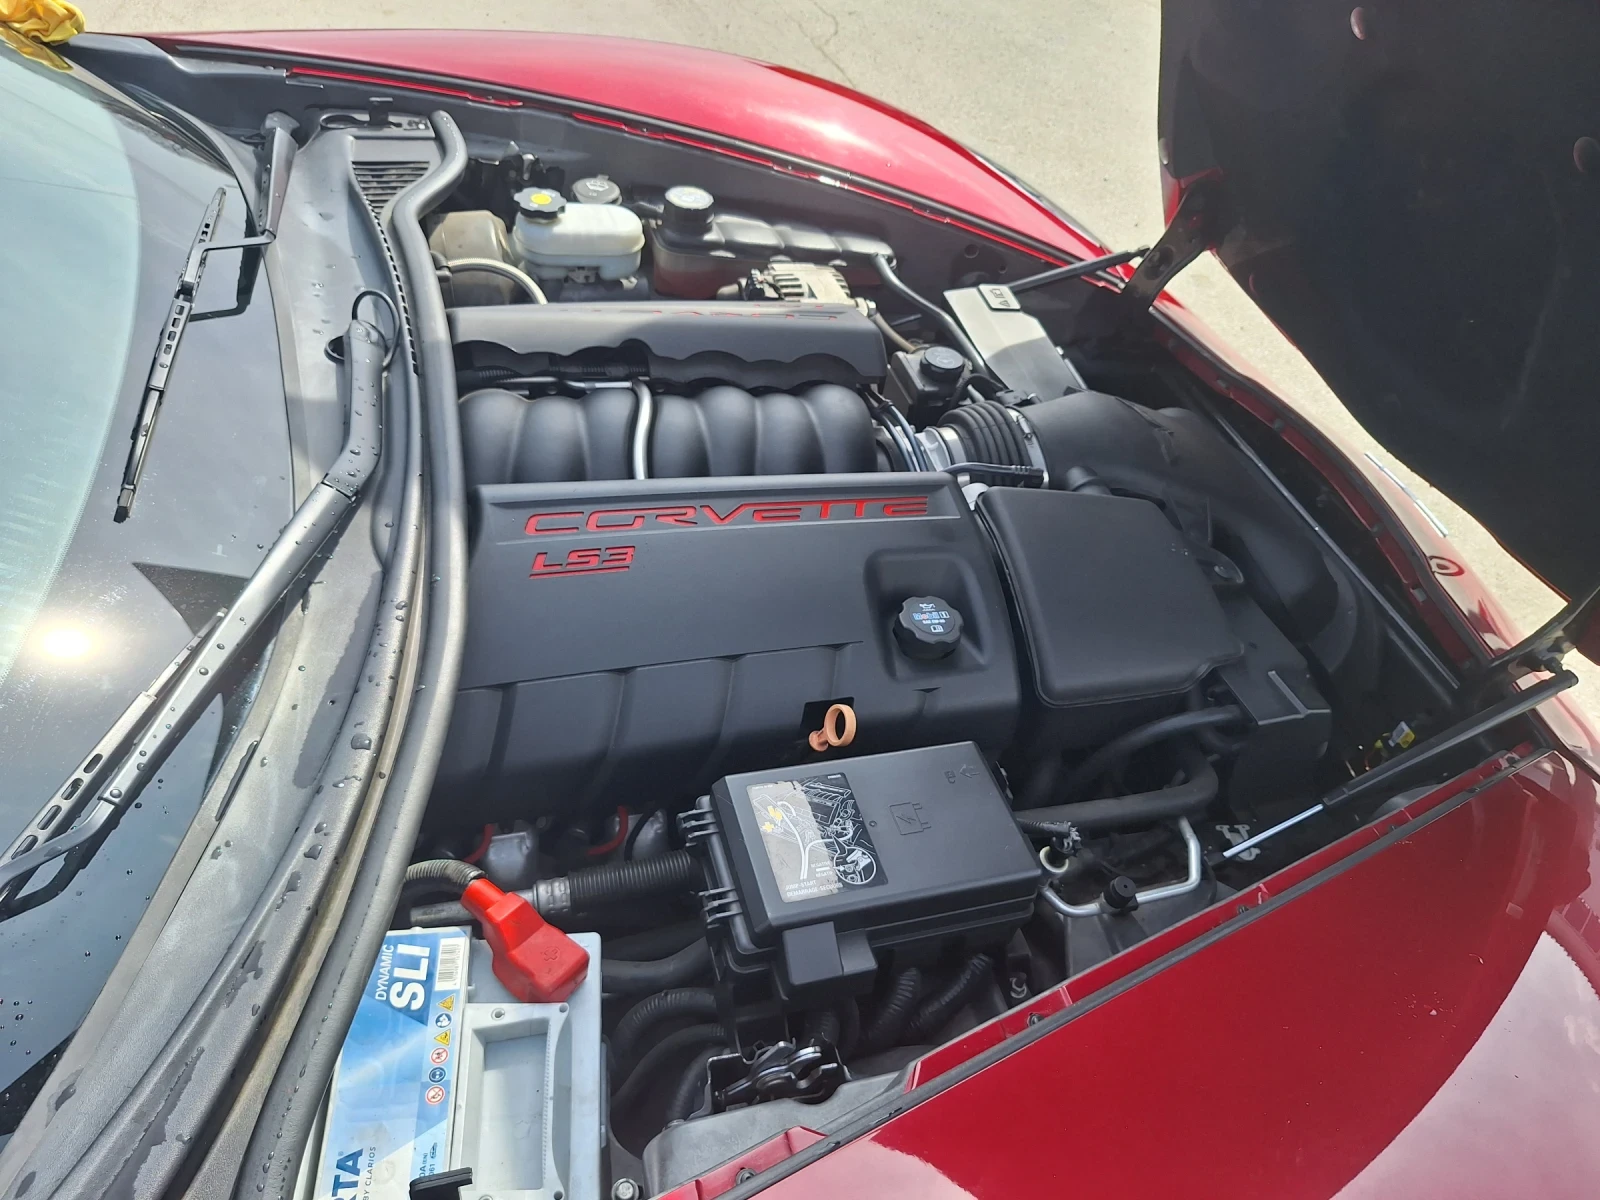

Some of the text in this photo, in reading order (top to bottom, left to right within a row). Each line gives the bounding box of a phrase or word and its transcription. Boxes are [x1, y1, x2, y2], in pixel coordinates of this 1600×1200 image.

[524, 496, 928, 535] CORVETTE
[530, 545, 636, 572] LS3
[375, 944, 394, 1000] DYNAMIC
[389, 944, 430, 1010] SLI
[365, 1146, 376, 1187] CLARIOS
